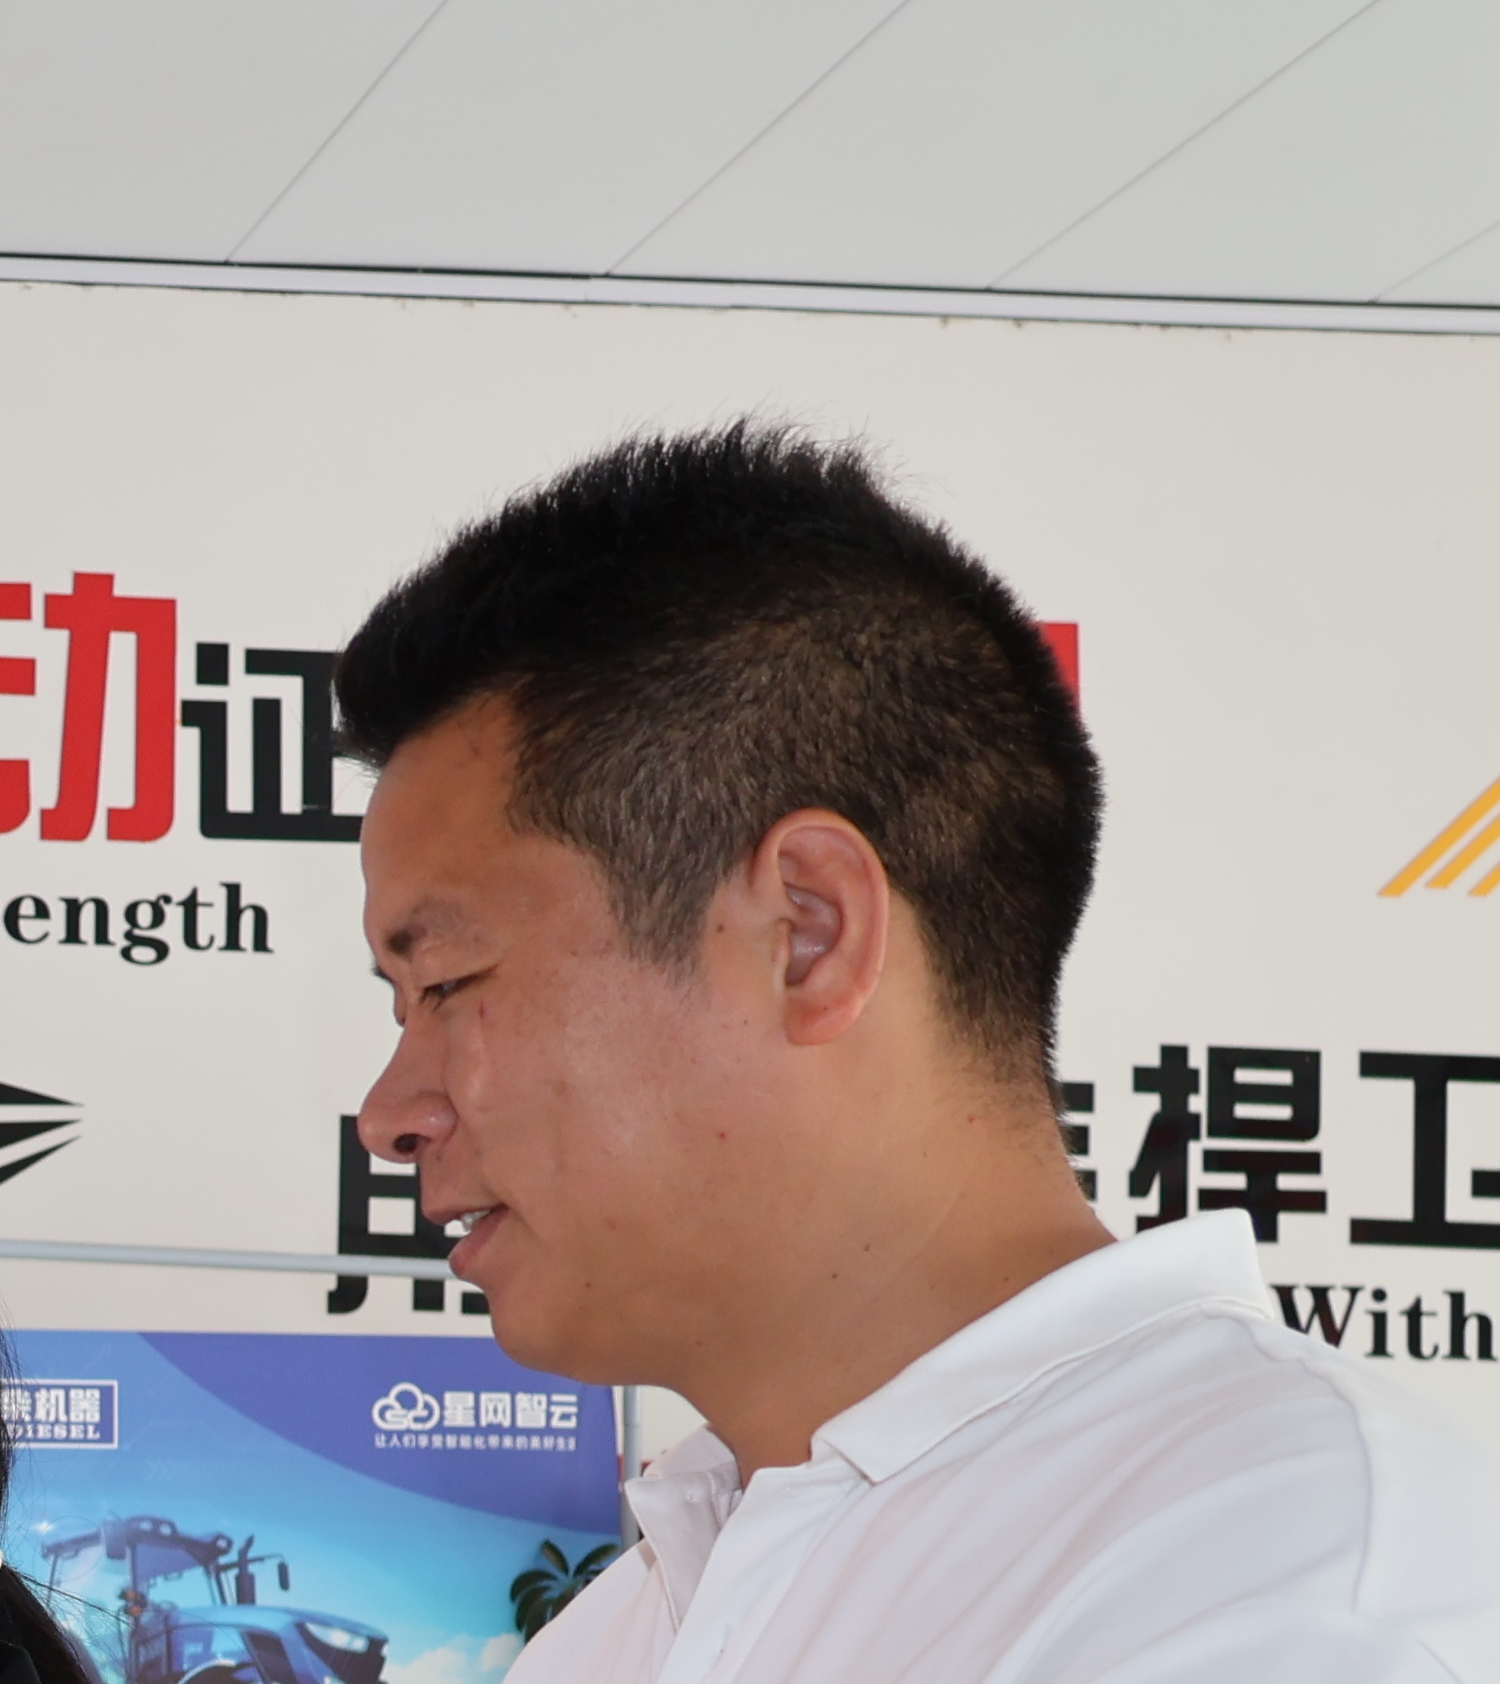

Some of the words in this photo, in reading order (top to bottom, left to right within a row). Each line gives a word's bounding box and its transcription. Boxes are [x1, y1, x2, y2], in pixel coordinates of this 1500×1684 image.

[1062, 1045, 1500, 1250] 捍卫
[1272, 1283, 1498, 1362] With
[443, 1390, 578, 1429] 星网智云
